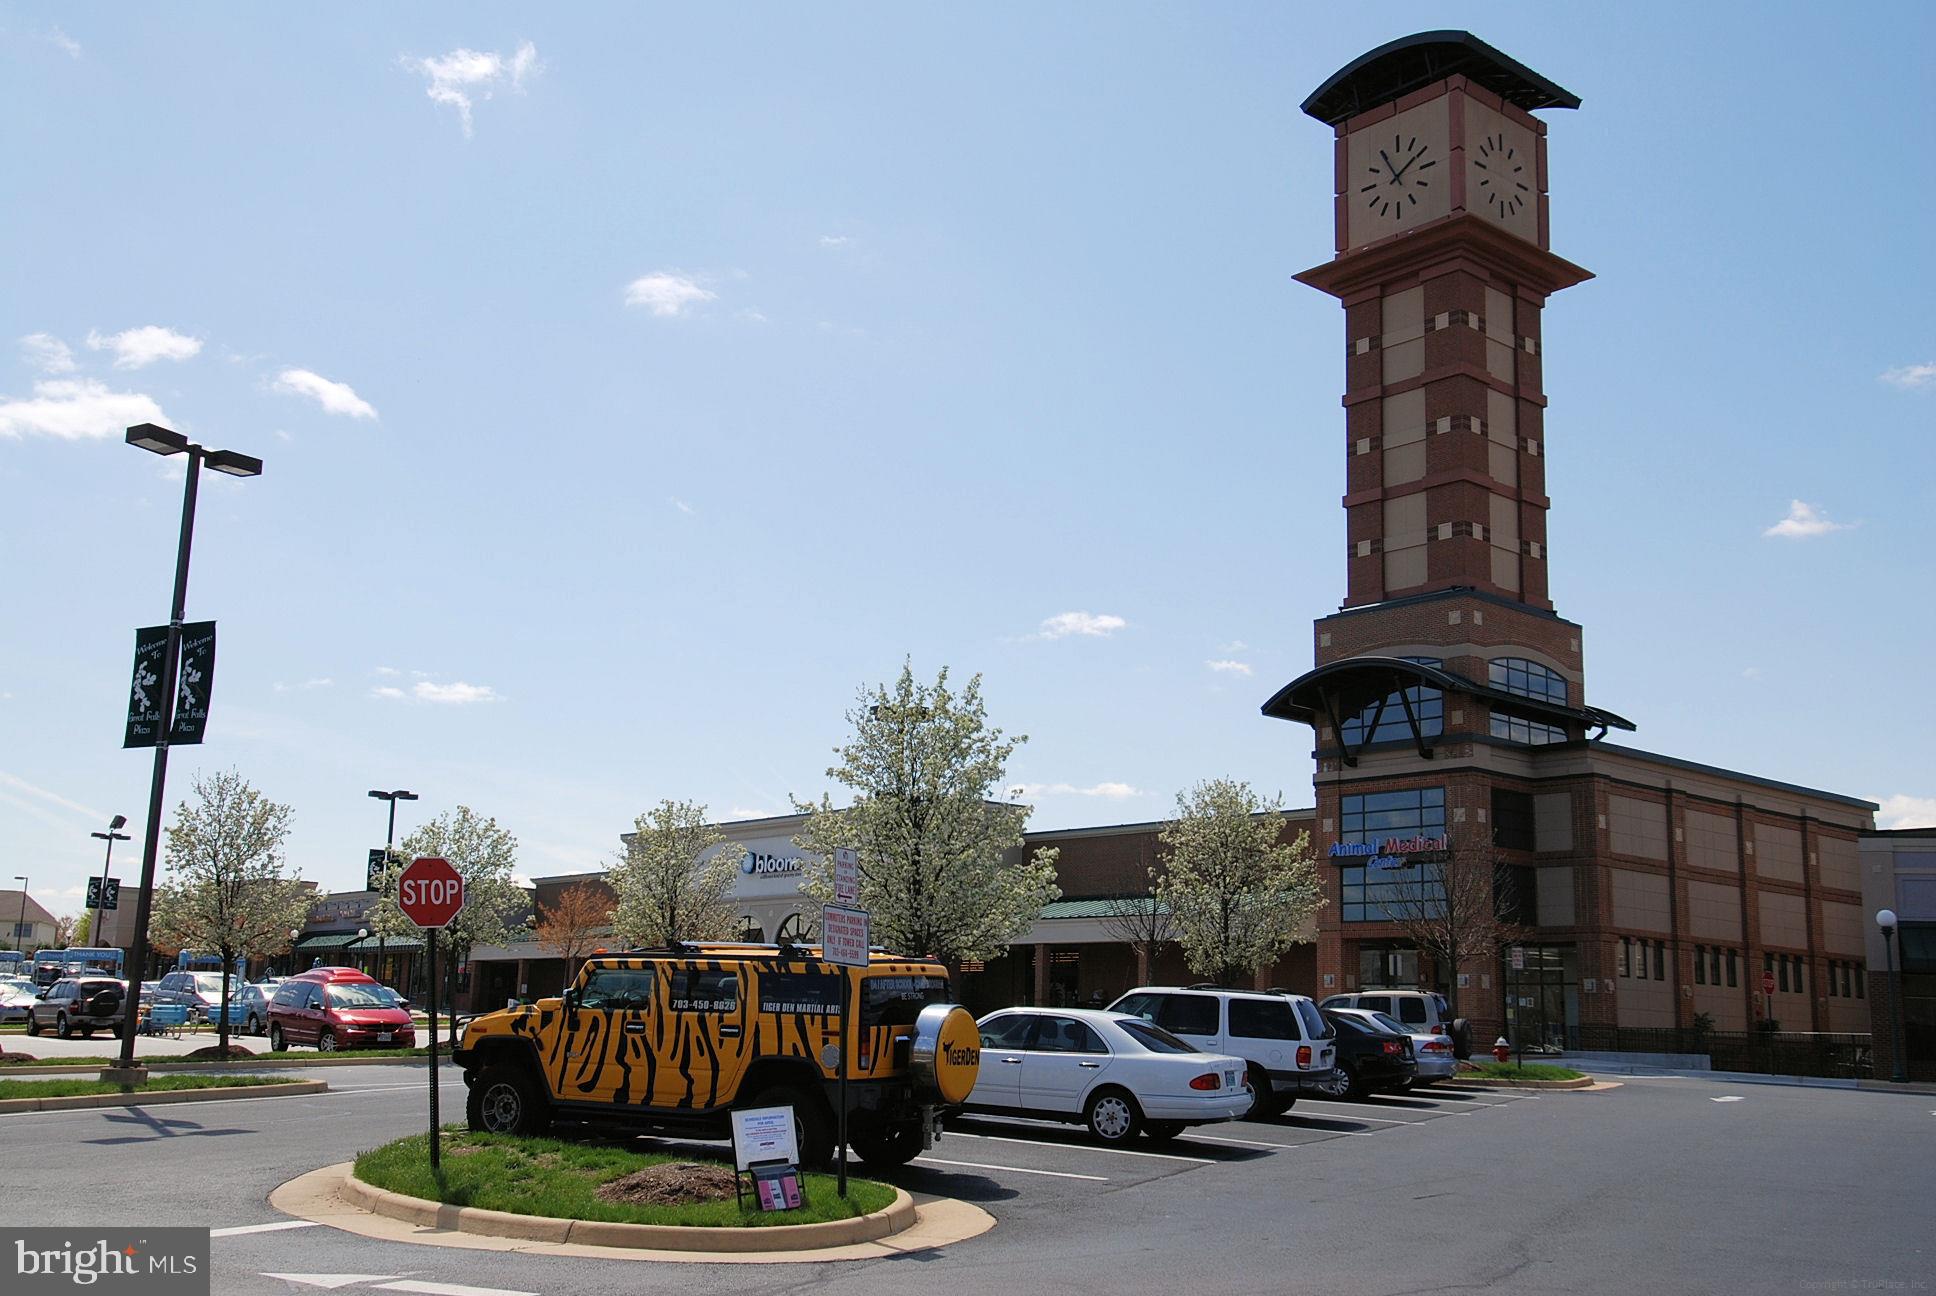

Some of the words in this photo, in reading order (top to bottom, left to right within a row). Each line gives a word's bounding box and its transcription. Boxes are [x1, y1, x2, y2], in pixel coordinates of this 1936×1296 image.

[183, 635, 213, 652] Welcome
[1328, 838, 1380, 857] Animal
[1384, 833, 1448, 854] Medical
[755, 853, 802, 873] bloom
[403, 879, 459, 906] STOP
[763, 1002, 780, 1011] TIGER
[781, 1003, 796, 1012] DEN
[796, 1004, 824, 1014] MARTIAL
